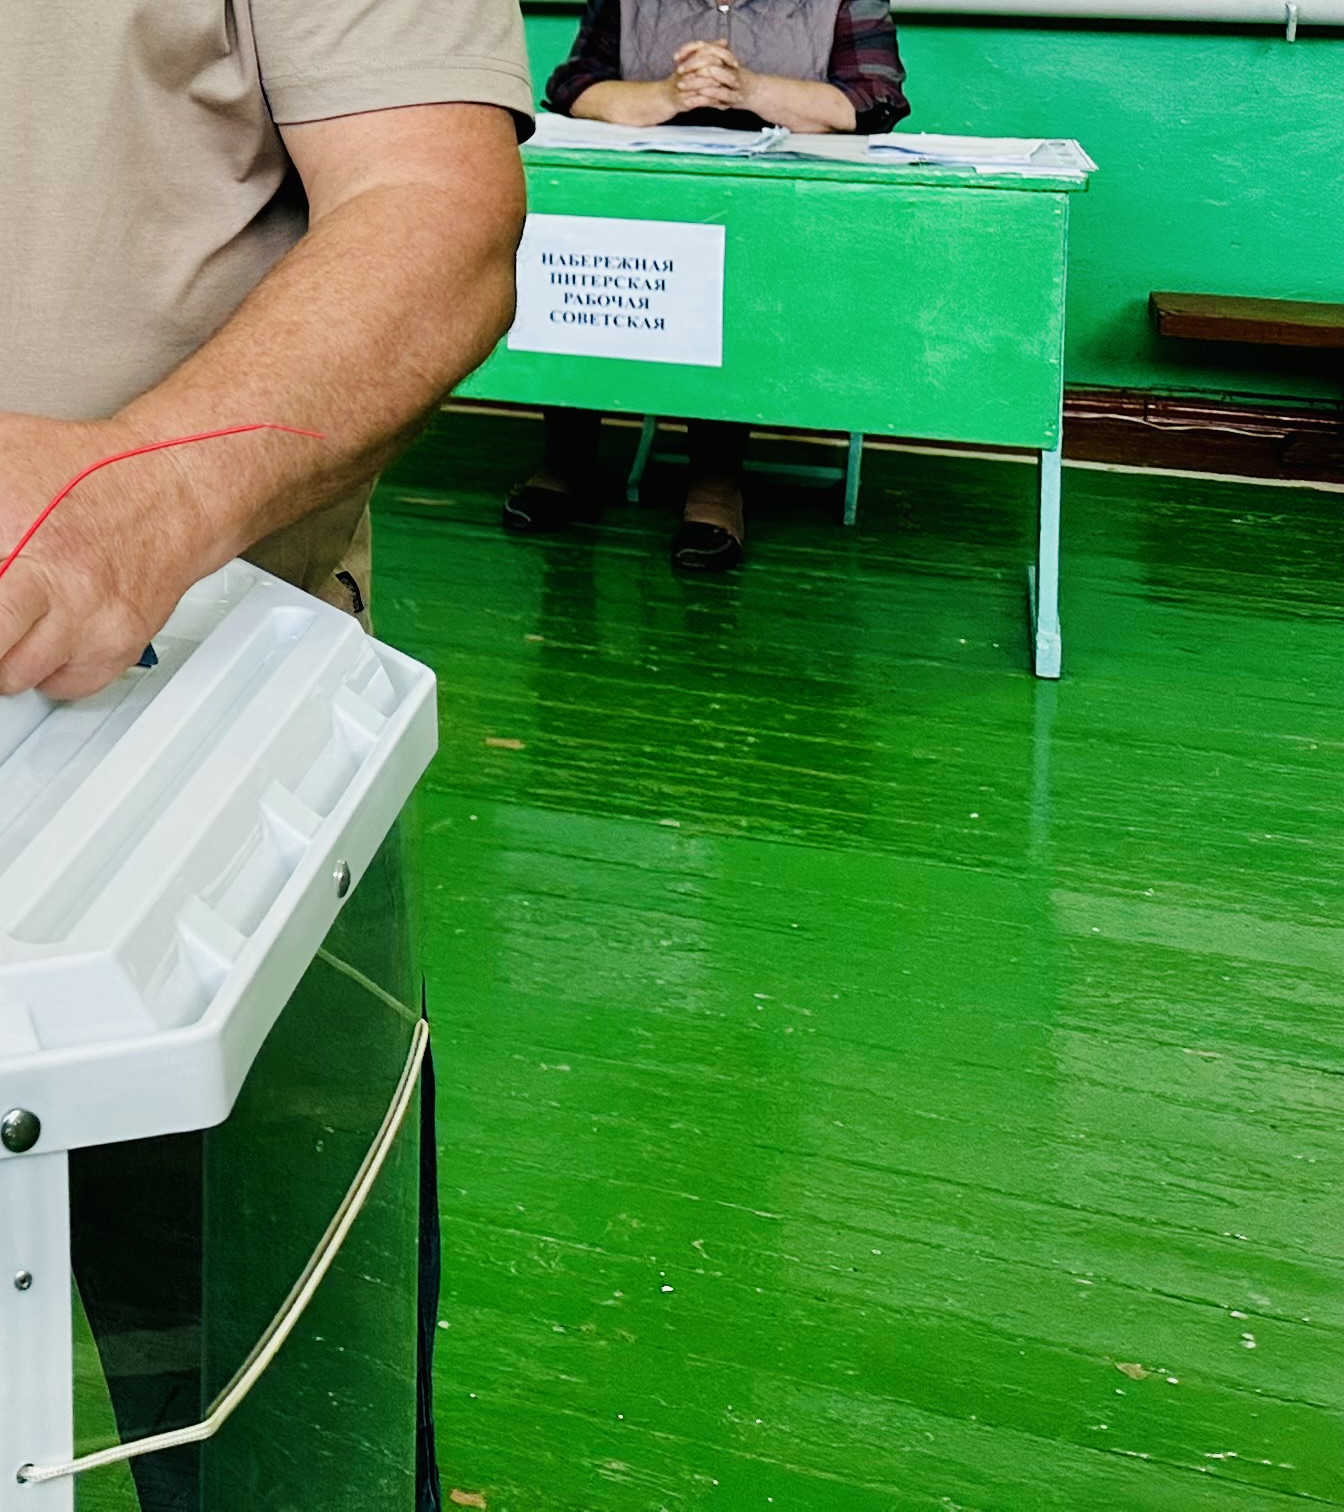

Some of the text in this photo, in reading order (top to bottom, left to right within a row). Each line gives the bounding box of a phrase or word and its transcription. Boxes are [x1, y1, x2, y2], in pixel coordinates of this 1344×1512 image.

[541, 252, 674, 273] НАБЕРЕЖНАЯ
[551, 273, 665, 291] ПИТЕРСКАЯ
[563, 292, 650, 310] РАБОЧАЯ
[550, 311, 665, 330] СОВЕТСКАЯ
